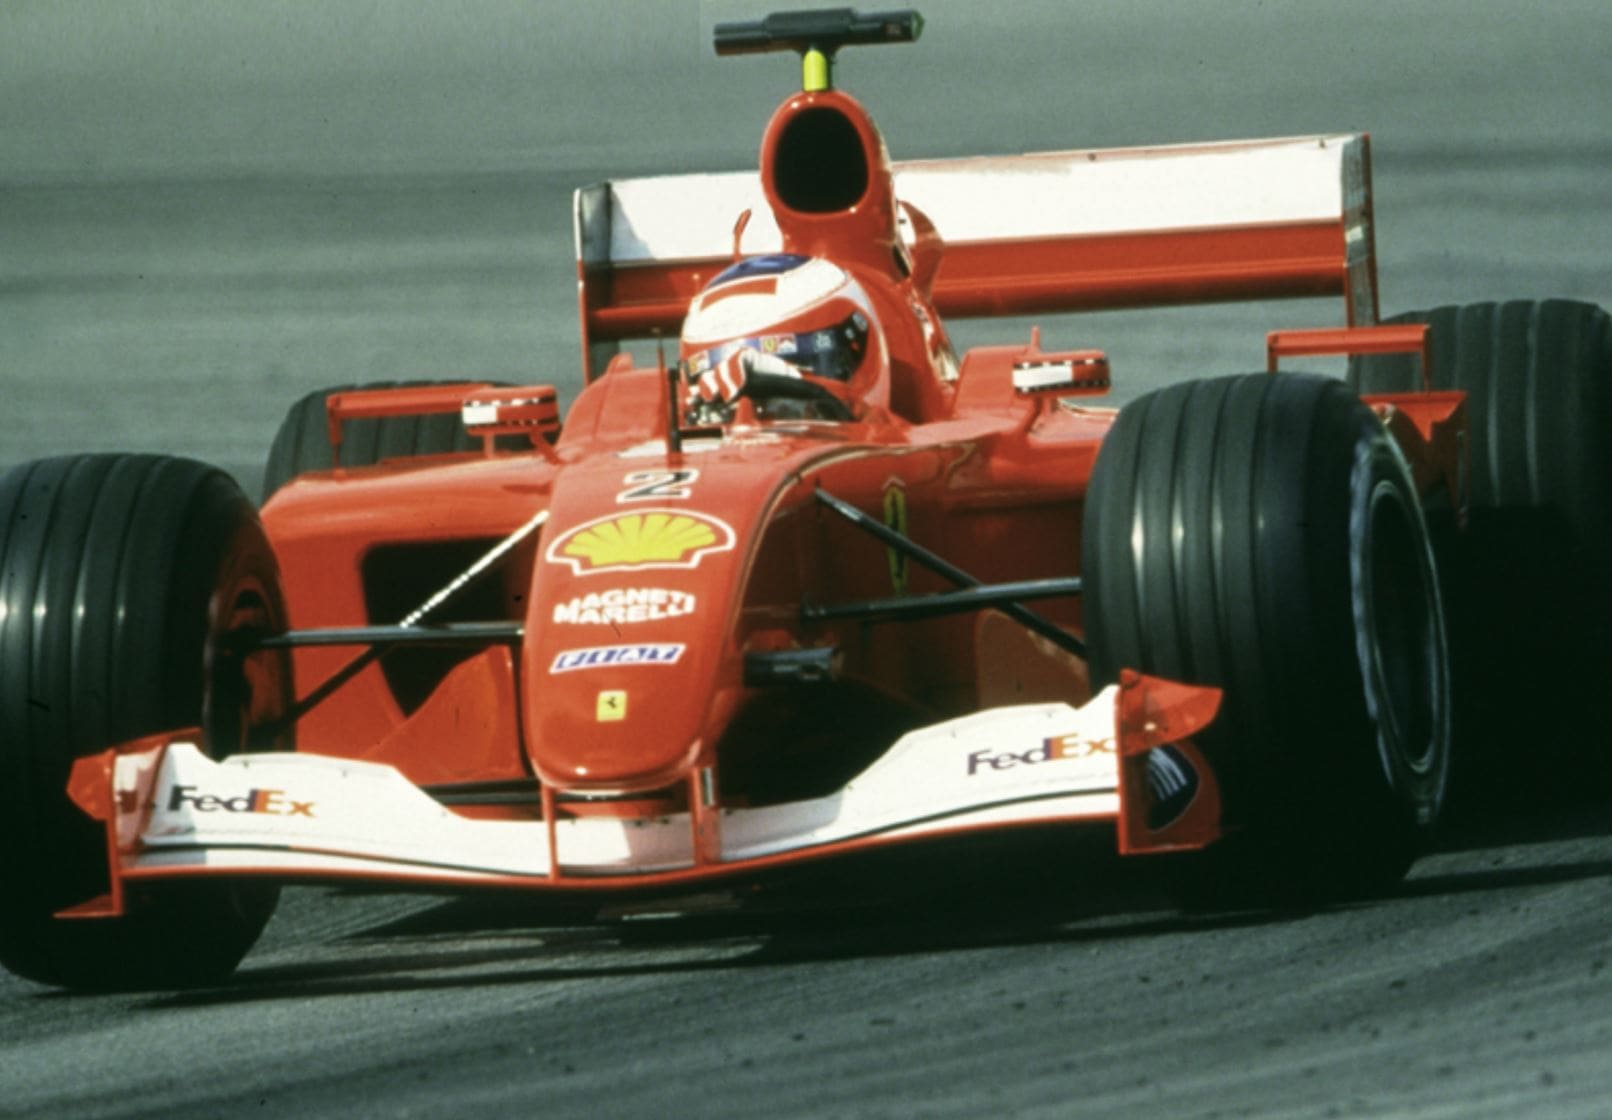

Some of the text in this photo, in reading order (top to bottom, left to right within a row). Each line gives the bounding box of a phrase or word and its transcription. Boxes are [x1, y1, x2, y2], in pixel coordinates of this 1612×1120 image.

[616, 468, 699, 504] 2
[553, 598, 695, 624] MARELLI
[566, 587, 695, 609] MAGNETI
[967, 731, 1117, 776] FedEx
[167, 785, 315, 818] FedEx
